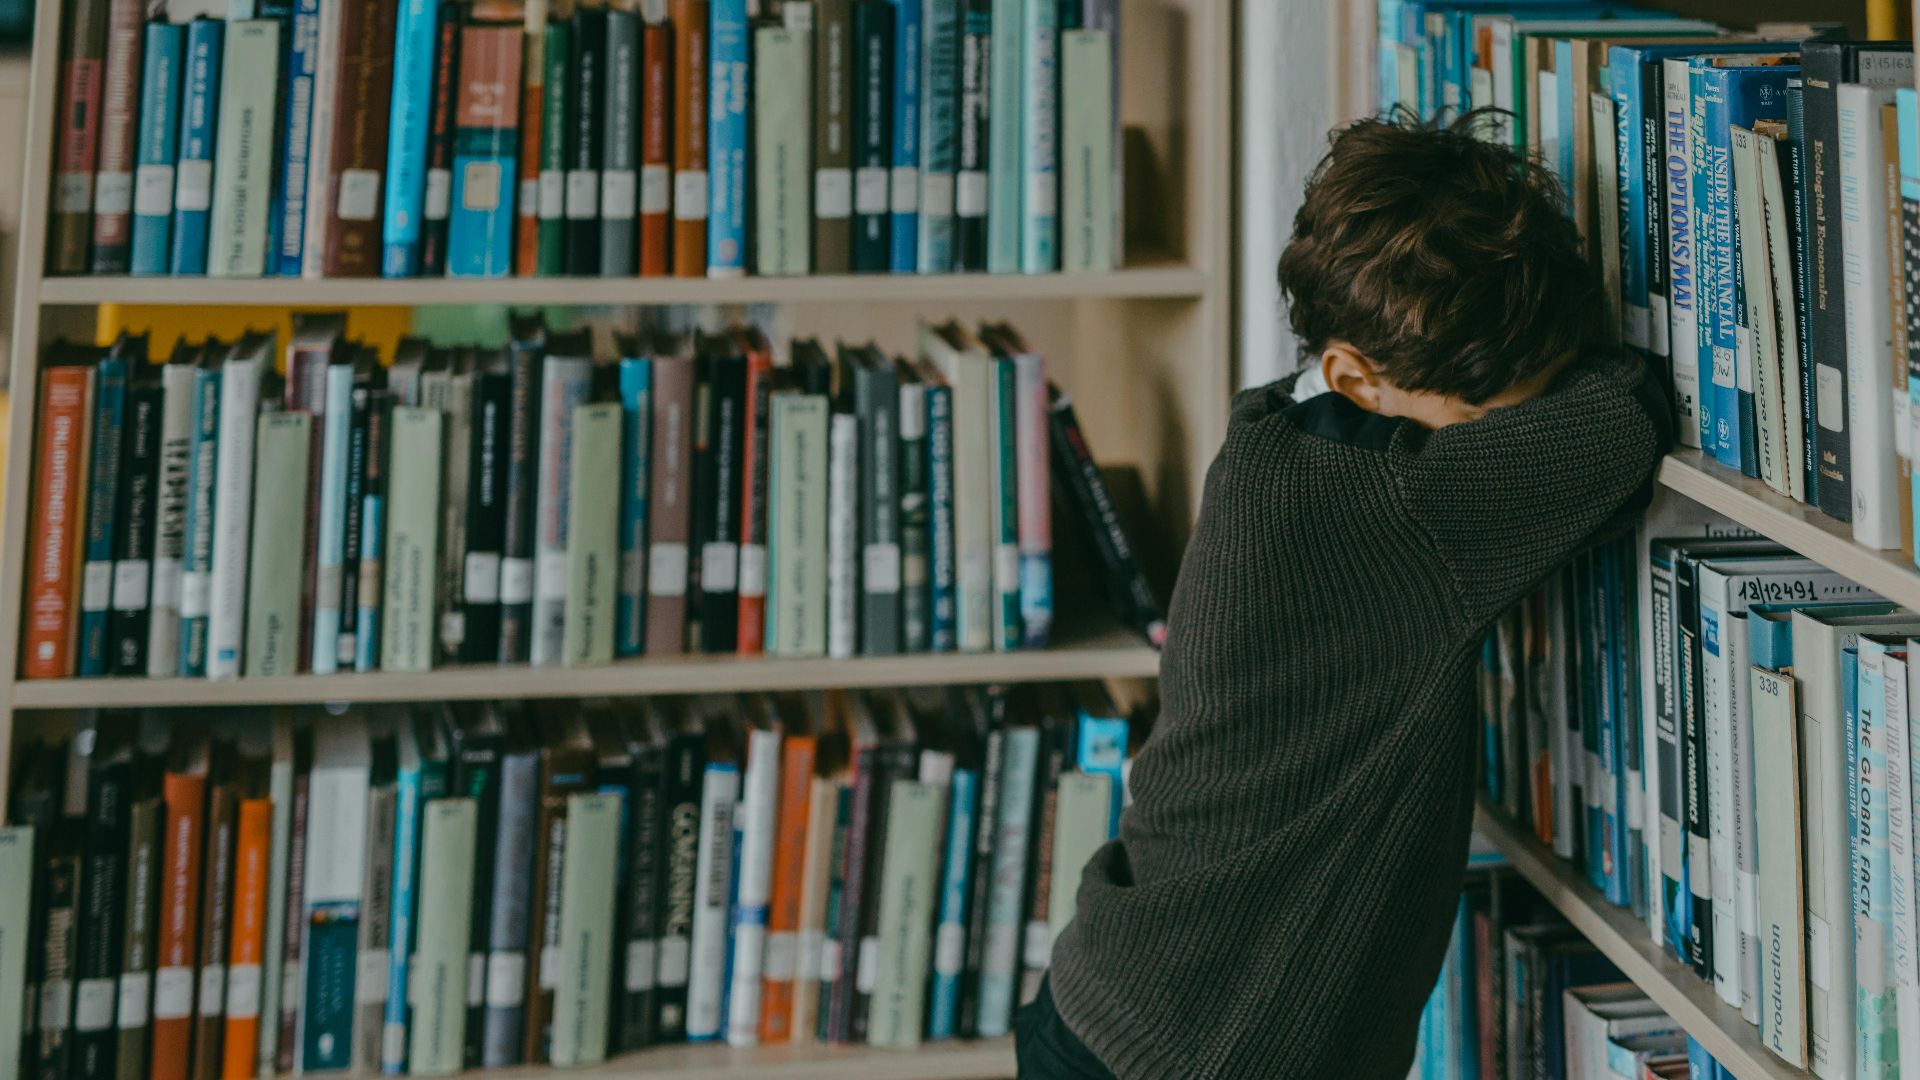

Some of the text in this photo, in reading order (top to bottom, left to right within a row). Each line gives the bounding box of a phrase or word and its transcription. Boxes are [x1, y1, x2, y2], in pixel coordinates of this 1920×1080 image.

[1668, 107, 1686, 153] THE
[1714, 146, 1729, 203] INSIDE
[1888, 164, 1896, 209] NATURAL
[1668, 155, 1690, 259] OPTIONS
[1706, 144, 1717, 313] FUTURES MARKETS
[1715, 206, 1731, 243] THE
[1794, 189, 1802, 232] RESOURCE
[1814, 139, 1828, 310] Ecological Economics
[1703, 264, 1711, 284] Fifty
[1716, 244, 1734, 339] FINANCIAL
[1796, 237, 1805, 298] POLICYMAKING
[1704, 287, 1712, 323] Insiders
[1799, 302, 1805, 312] IN
[1799, 316, 1807, 368] DEVELOPING
[1753, 305, 1772, 482] economics Land
[43, 416, 71, 583] ENLIGHTENED POWER
[1654, 592, 1663, 685] ECONOMICS
[1661, 596, 1673, 716] INTERNATIONAL
[1729, 642, 1738, 751] TRANSFORMATIONS
[1734, 752, 1739, 766] IN
[1758, 676, 1779, 696] 338
[1885, 675, 1900, 722] FROM
[1683, 634, 1698, 825] INTERNATIONAL ECONOMICS
[1846, 711, 1855, 762] AMERICAN
[1861, 709, 1871, 748] THE
[1886, 724, 1900, 756] THE
[1848, 766, 1857, 818] INDUSTRY
[1861, 757, 1871, 846] GLOBAL
[1887, 759, 1903, 828] GROUND
[1891, 831, 1904, 855] UP
[1892, 864, 1905, 920] JOHN
[1771, 923, 1783, 1053] Production
